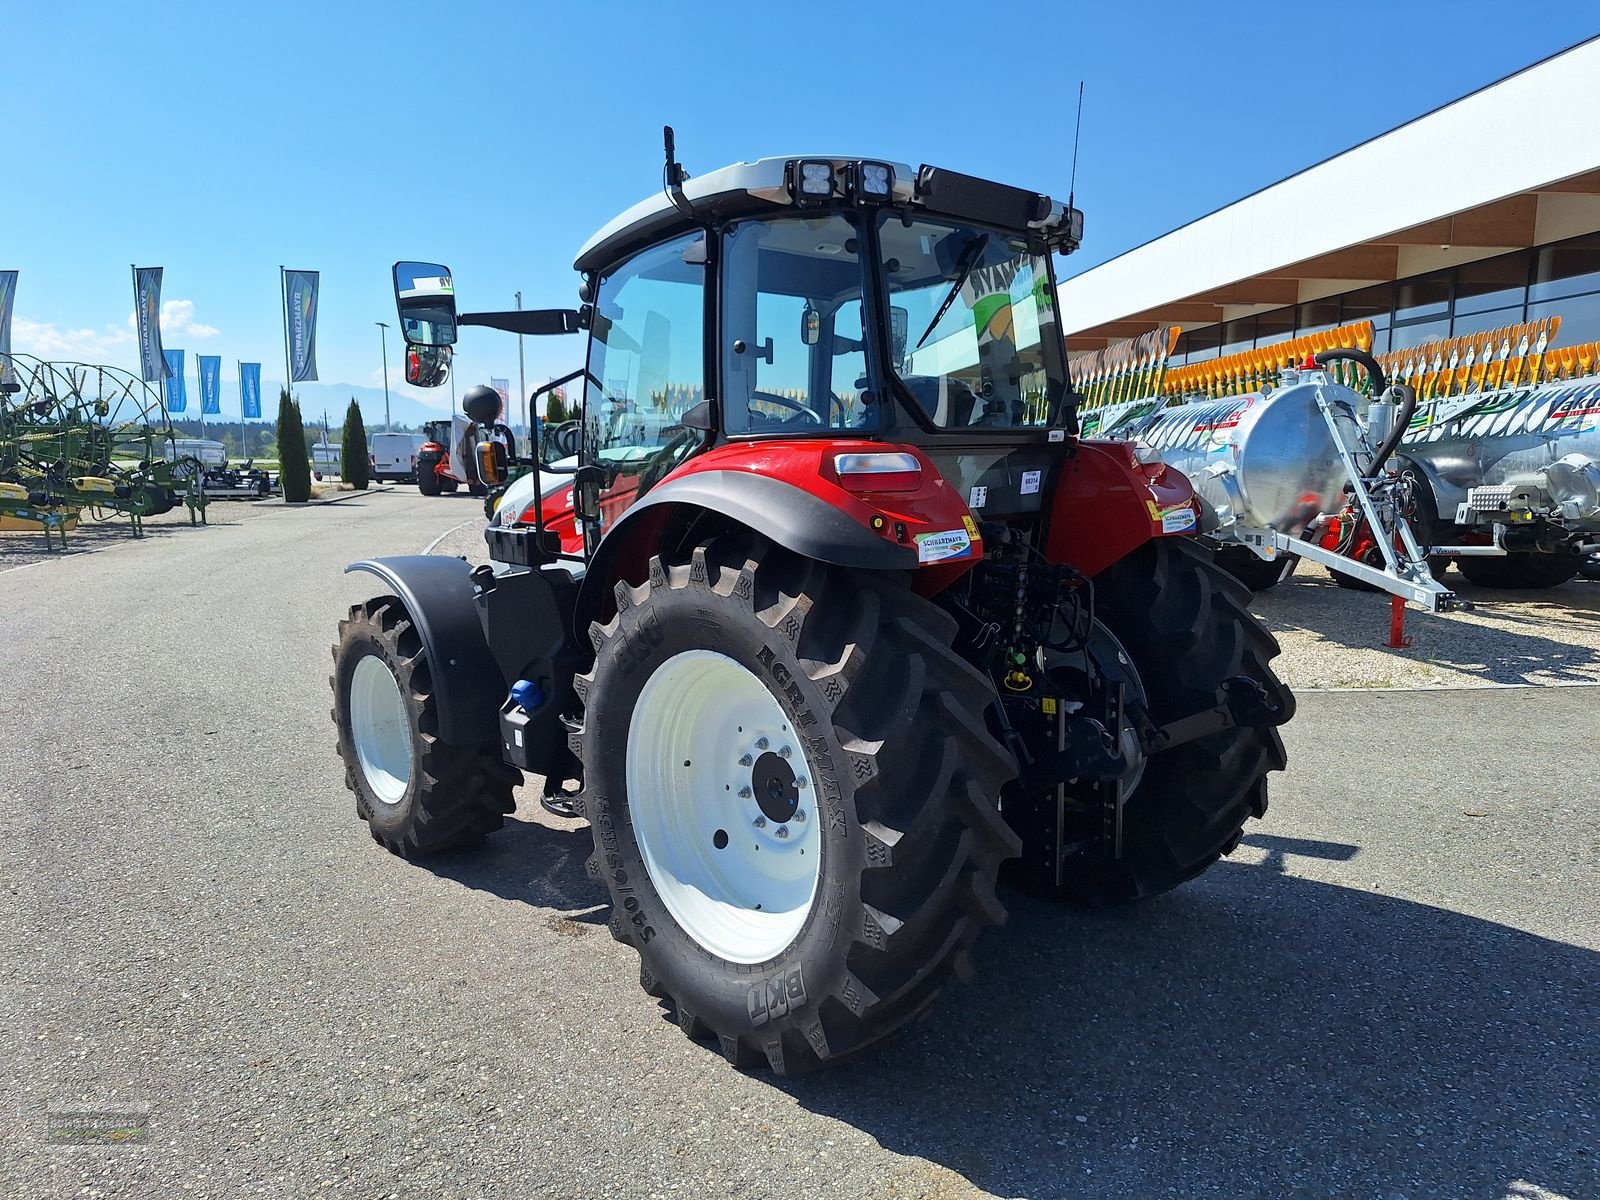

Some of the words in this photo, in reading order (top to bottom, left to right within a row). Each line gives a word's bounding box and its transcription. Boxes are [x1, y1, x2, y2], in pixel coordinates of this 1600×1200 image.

[140, 289, 153, 367] SCHWARZMAYR
[293, 292, 304, 368] SCHWARZMAYR
[922, 536, 962, 547] SCHWARZMAYR
[597, 795, 657, 944] 540/65R34
[748, 966, 806, 1023] BKT
